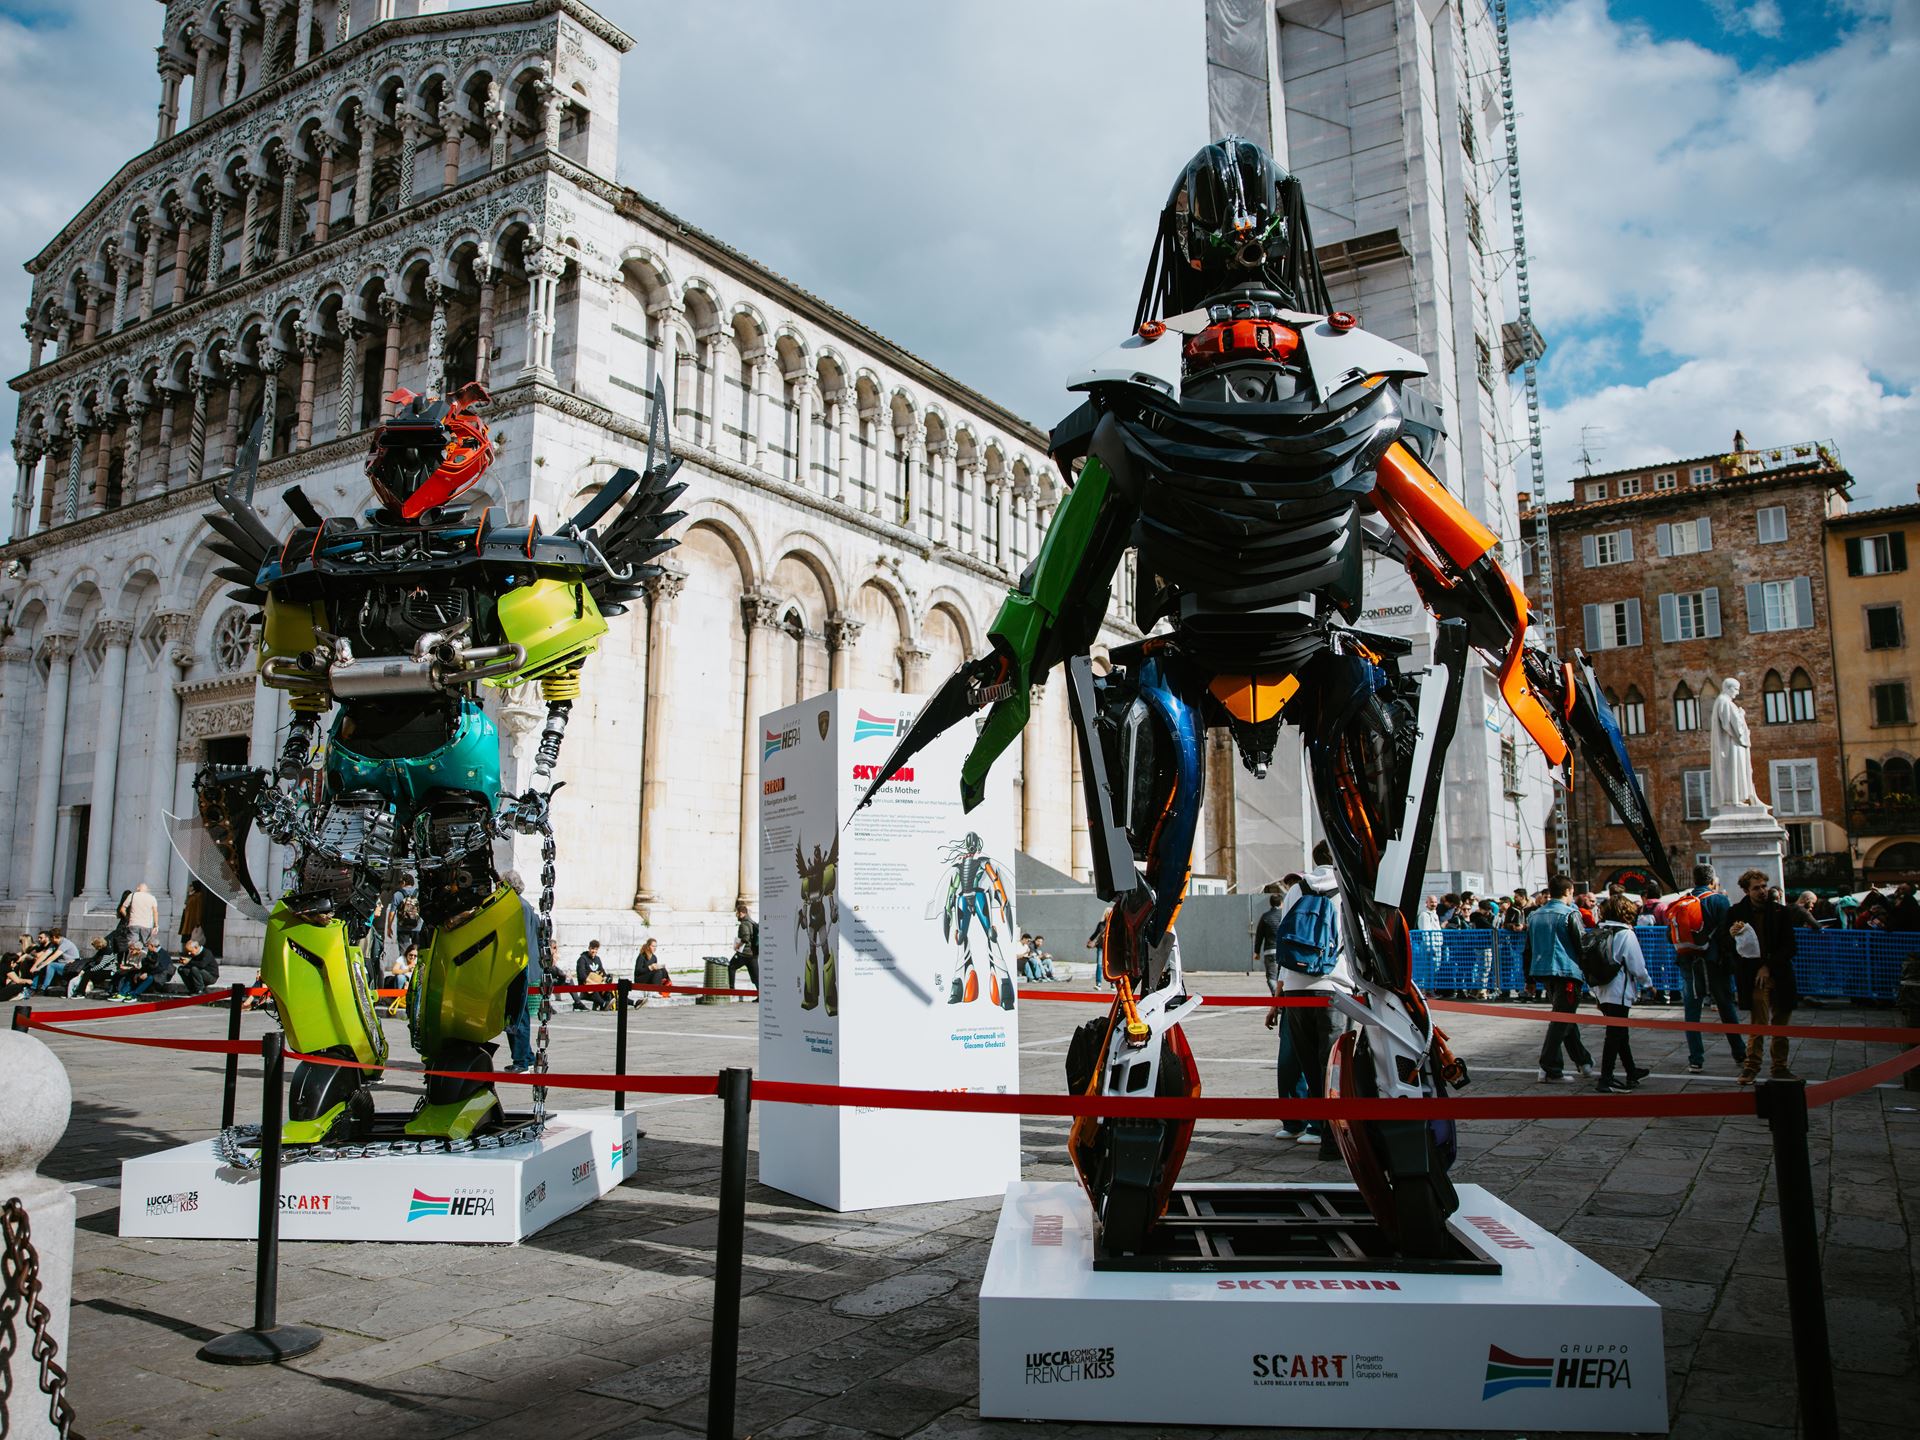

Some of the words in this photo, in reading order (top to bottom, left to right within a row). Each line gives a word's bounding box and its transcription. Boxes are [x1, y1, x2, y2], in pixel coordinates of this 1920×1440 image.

[1361, 605, 1413, 618] CONTRUCCI
[894, 786, 920, 795] Mother
[951, 1034, 972, 1042] Giuseppe
[147, 1194, 173, 1206] LUCCA
[188, 1191, 198, 1200] 25
[279, 1195, 332, 1210] SCART
[146, 1202, 178, 1216] FRENCH
[180, 1200, 198, 1212] KISS
[450, 1197, 495, 1216] HERA
[1217, 1279, 1402, 1291] SKYRENN
[1560, 1344, 1629, 1354] GRUPPO
[1026, 1351, 1070, 1368] LUCCA
[1070, 1348, 1097, 1357] COMICS
[1098, 1347, 1115, 1362] 25
[1070, 1355, 1098, 1364] &GAMES
[1355, 1354, 1384, 1363] Progetto
[1025, 1364, 1080, 1384] FRENCH
[1084, 1361, 1115, 1379] KISS
[1252, 1354, 1348, 1378] SCART
[1356, 1371, 1381, 1380] Gruppo
[1382, 1371, 1399, 1379] Hera
[1556, 1358, 1632, 1389] HERA
